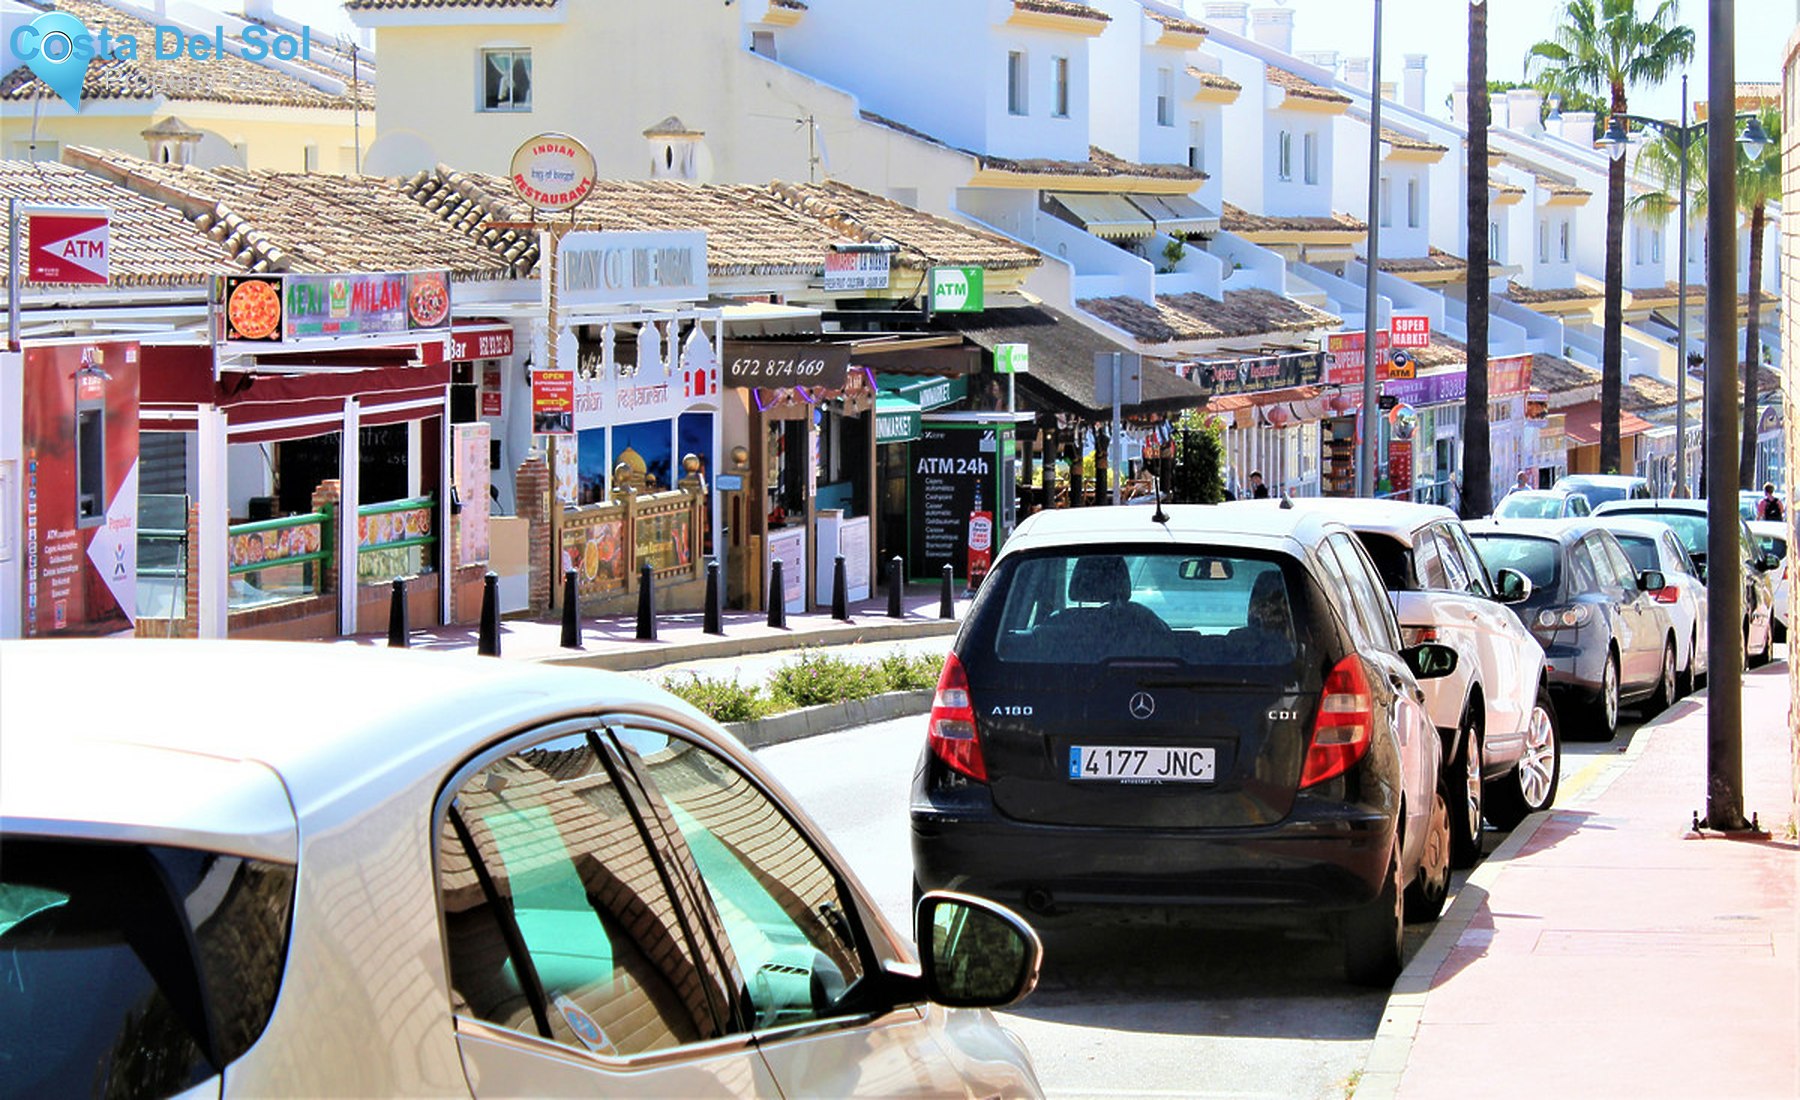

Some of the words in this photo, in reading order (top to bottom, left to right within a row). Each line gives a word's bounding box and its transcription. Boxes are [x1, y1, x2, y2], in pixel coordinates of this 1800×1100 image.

[533, 144, 575, 157] INDIAN
[514, 174, 590, 204] RESTAURANT
[63, 240, 104, 258] ATM
[351, 279, 401, 312] MILAN
[935, 283, 966, 296] ATM
[1395, 318, 1425, 331] SUPER
[1392, 333, 1428, 345] MARKET
[731, 358, 761, 375] 672
[766, 359, 794, 376] 874
[797, 359, 825, 376] 669
[917, 458, 953, 474] ATM
[956, 458, 988, 474] 24h
[1267, 710, 1298, 721] CDI
[1085, 750, 1148, 775] 4177
[1157, 751, 1204, 777] JNC
